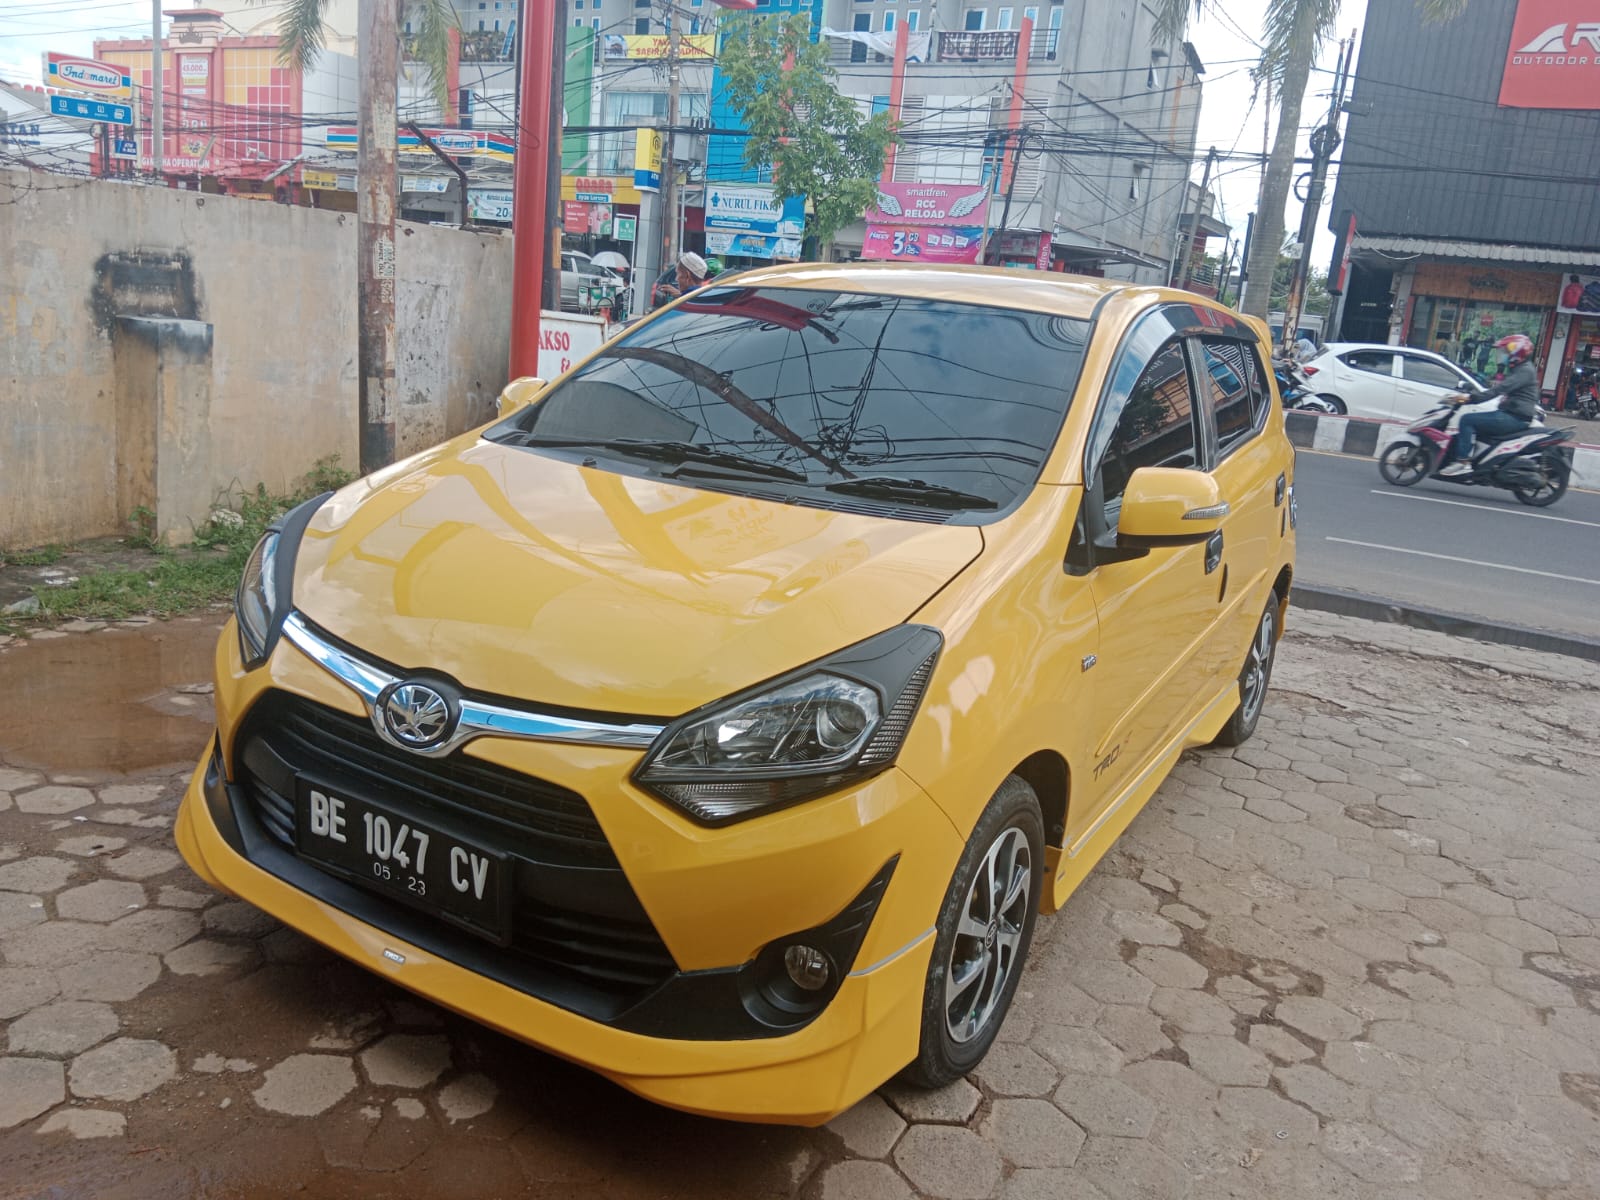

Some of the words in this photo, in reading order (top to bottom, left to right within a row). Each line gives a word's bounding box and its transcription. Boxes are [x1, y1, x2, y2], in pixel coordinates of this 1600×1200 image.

[1512, 56, 1588, 65] OUTDOOR
[63, 65, 117, 85] Indomaret
[722, 197, 753, 209] NURUL
[915, 200, 936, 209] RCC
[904, 210, 946, 219] RELOAD
[891, 231, 906, 256] 3
[311, 790, 347, 843] BE
[363, 811, 430, 875] 1047
[450, 846, 490, 901] CV
[373, 861, 391, 880] 05
[407, 875, 426, 896] 23
